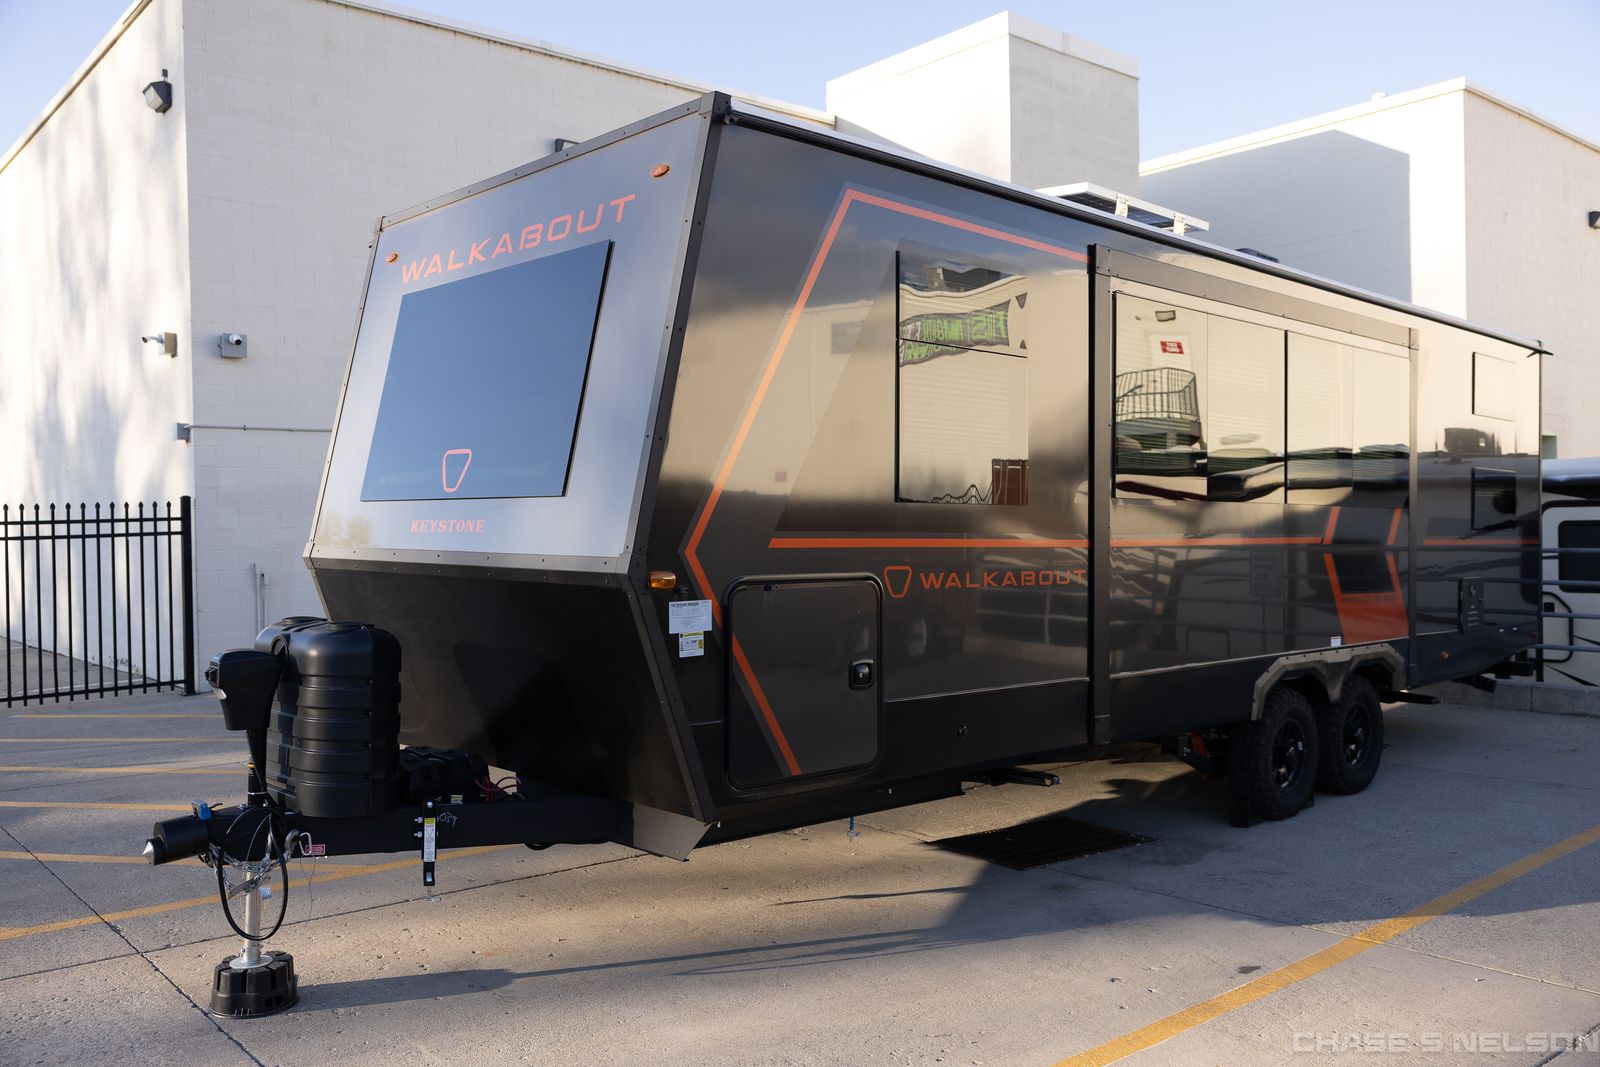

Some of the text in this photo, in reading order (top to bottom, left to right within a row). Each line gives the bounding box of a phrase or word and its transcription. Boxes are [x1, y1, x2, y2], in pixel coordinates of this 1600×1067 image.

[402, 194, 636, 284] WALKABOUT
[410, 519, 486, 533] KEYSTONE
[920, 569, 1087, 589] WALKABOUT
